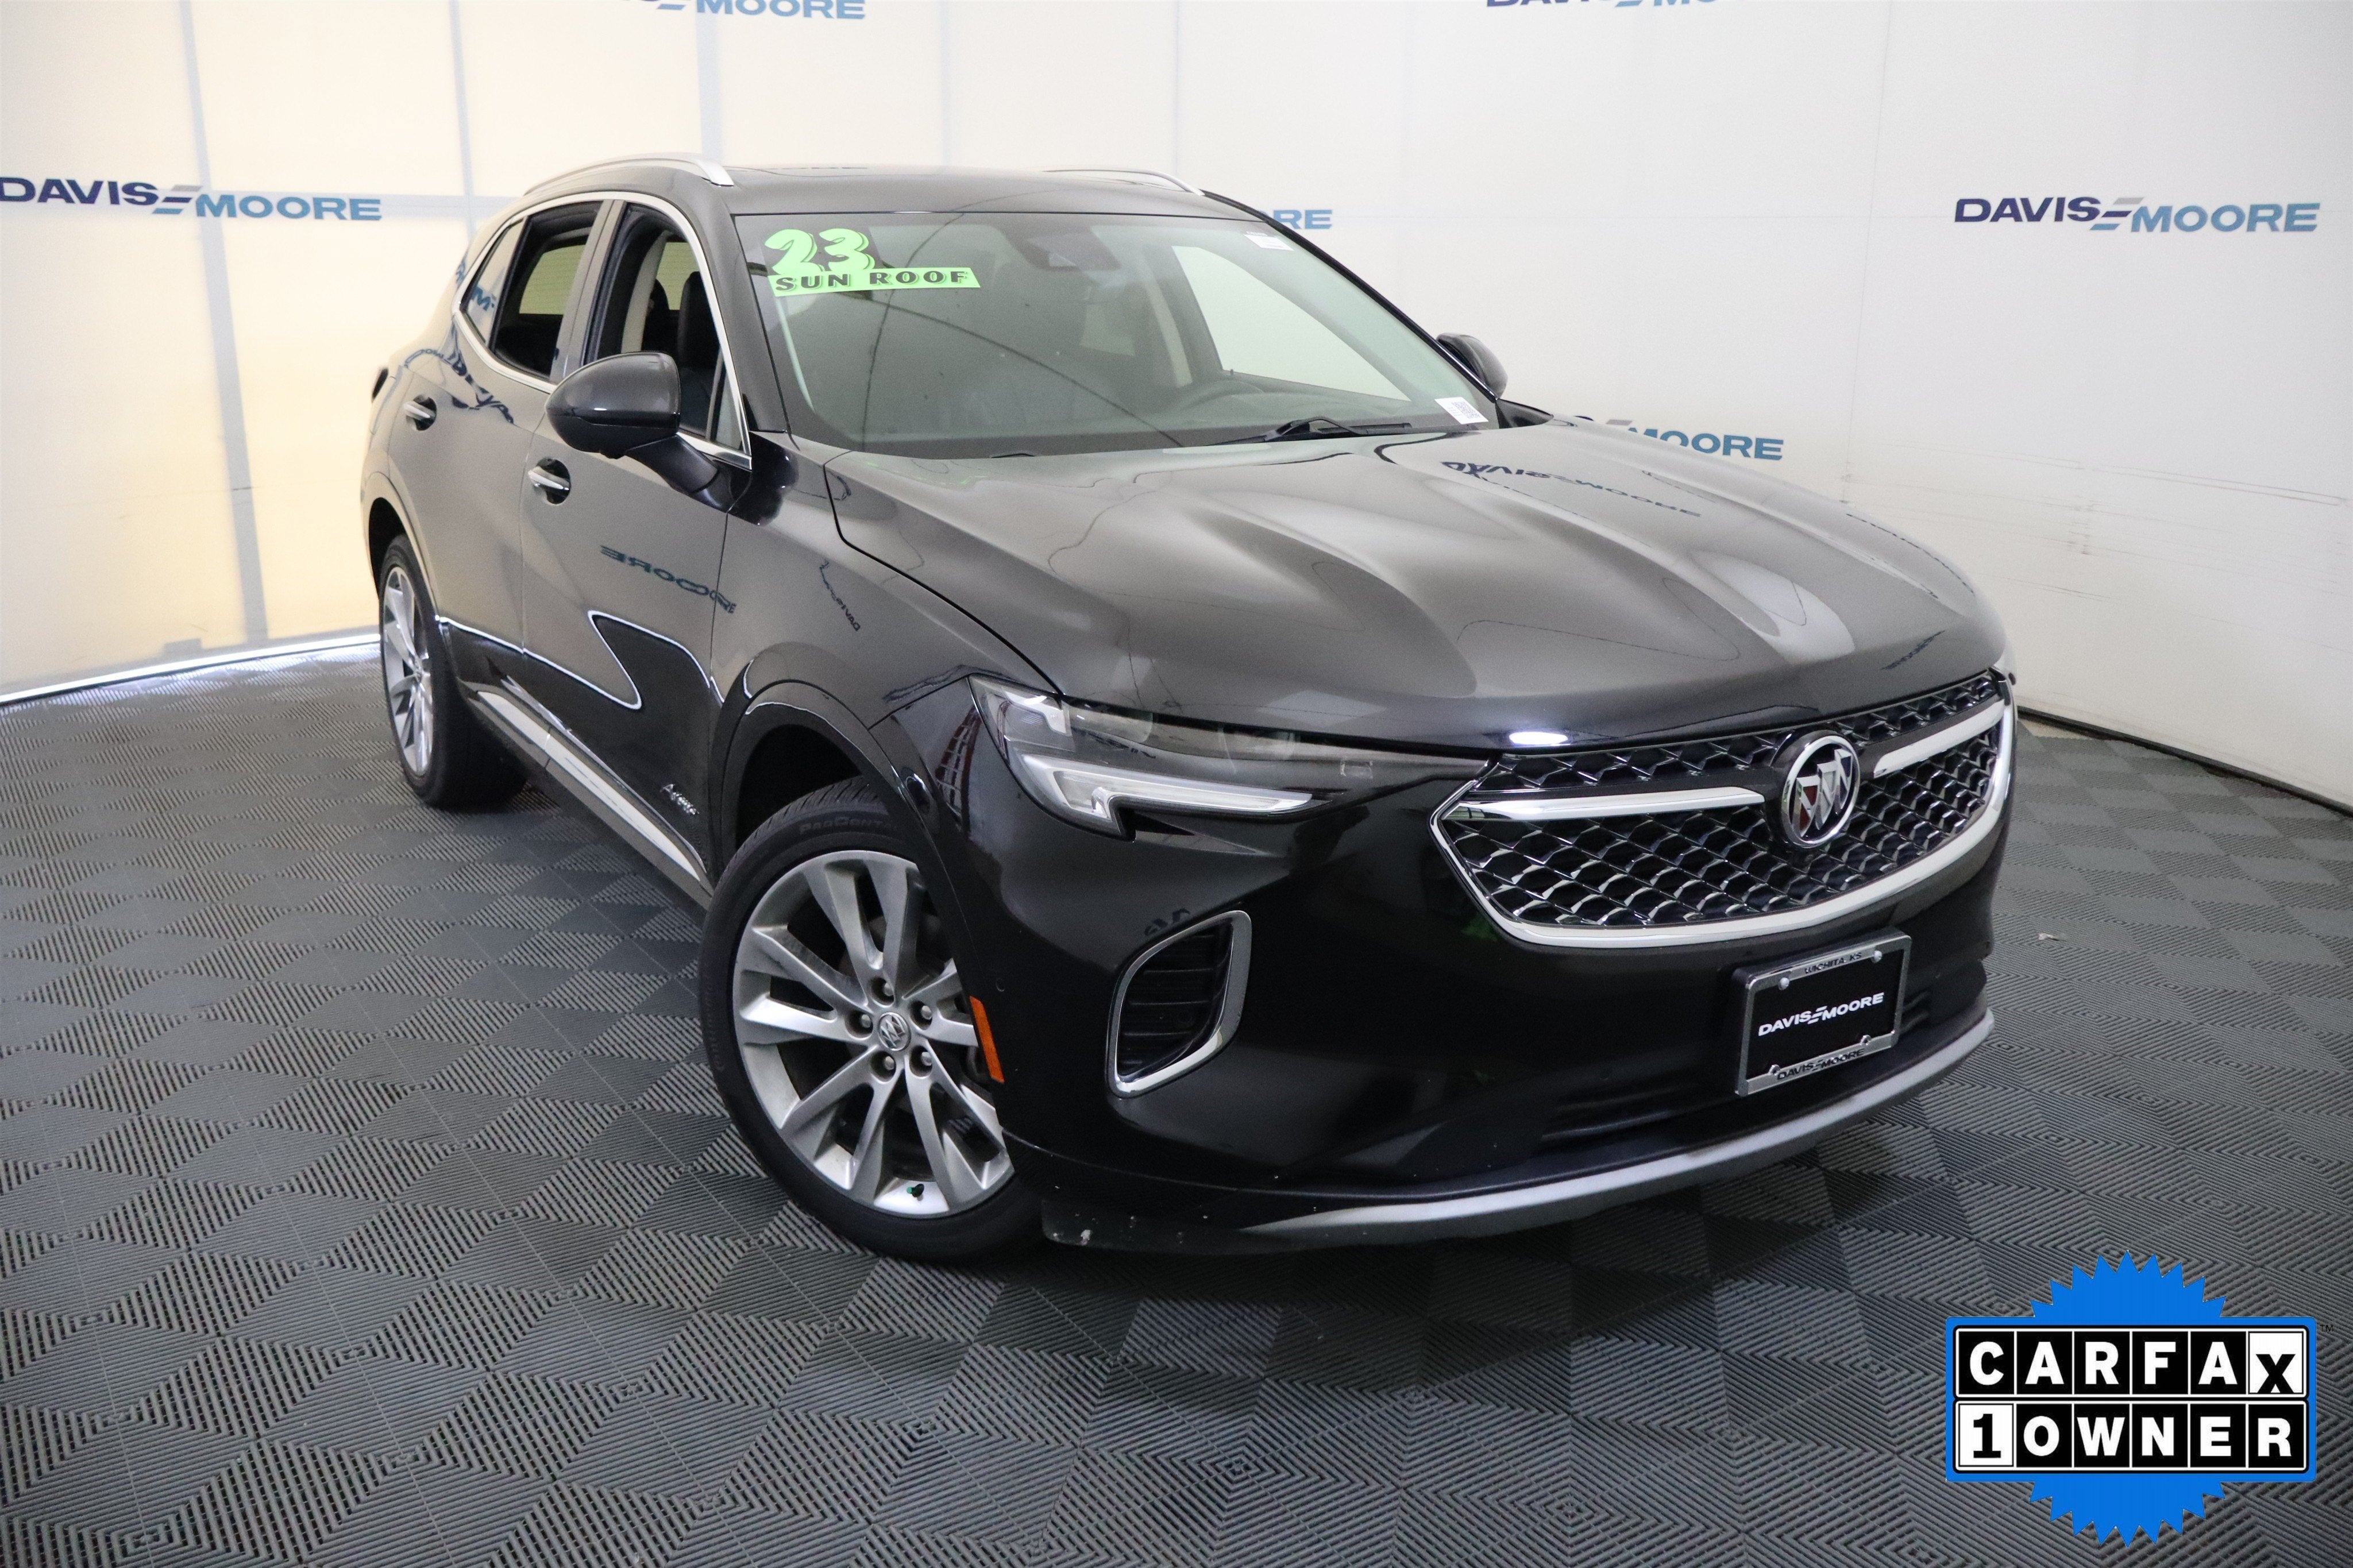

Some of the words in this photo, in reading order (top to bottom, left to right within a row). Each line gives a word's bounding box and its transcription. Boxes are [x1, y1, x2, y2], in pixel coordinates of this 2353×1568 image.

[696, 0, 866, 20] MOORE
[0, 176, 160, 206] DAVIS
[195, 194, 382, 221] MOORE
[1954, 196, 2101, 223] DAVIS
[2131, 202, 2321, 233] MOORE
[765, 228, 875, 275] 23
[776, 274, 850, 291] SUN
[869, 271, 967, 285] ROOF
[1849, 952, 1861, 961] KS
[1758, 1010, 1812, 1037] DAVIS
[1822, 992, 1885, 1021] MOORE
[1777, 1063, 1814, 1080] DAVIS
[1820, 1048, 1865, 1069] MOORE
